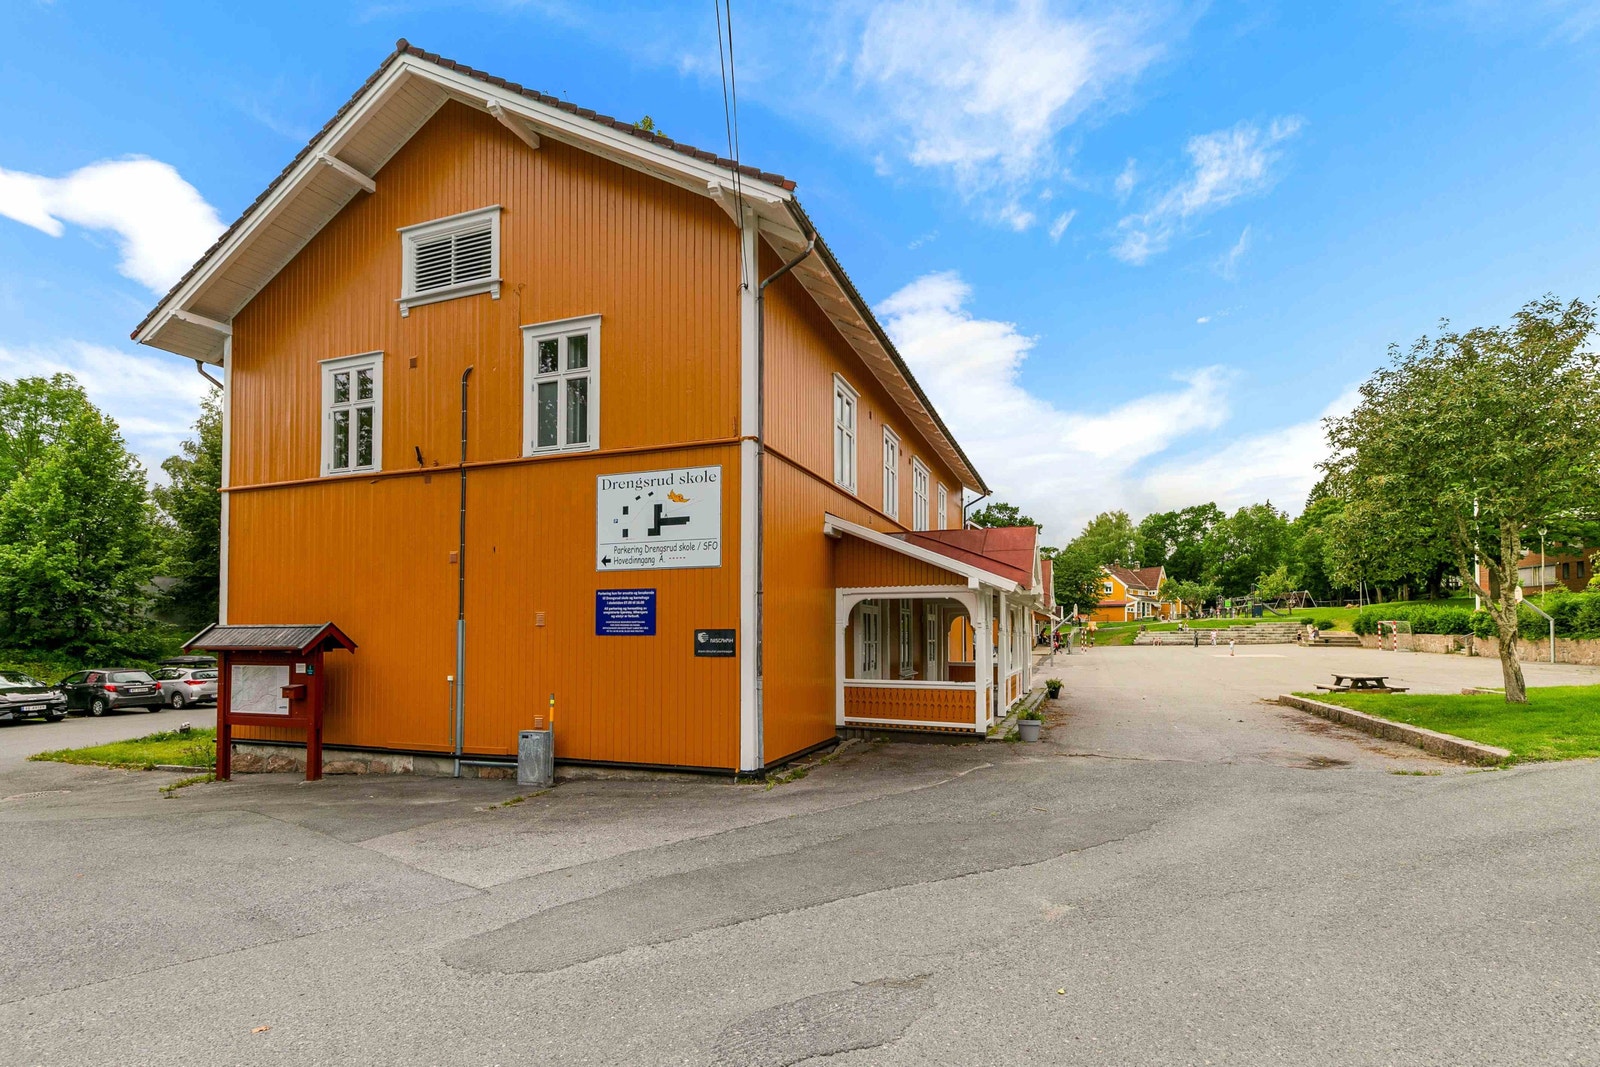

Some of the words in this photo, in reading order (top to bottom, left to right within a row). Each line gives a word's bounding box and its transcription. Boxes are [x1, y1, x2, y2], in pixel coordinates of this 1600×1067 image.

[602, 472, 674, 491] Drengsrud
[679, 470, 717, 485] skole
[613, 545, 643, 556] Parkering
[644, 543, 677, 555] Drengsrud
[678, 542, 695, 552] skole
[703, 541, 718, 551] SFO
[613, 555, 656, 566] Hovedinngang
